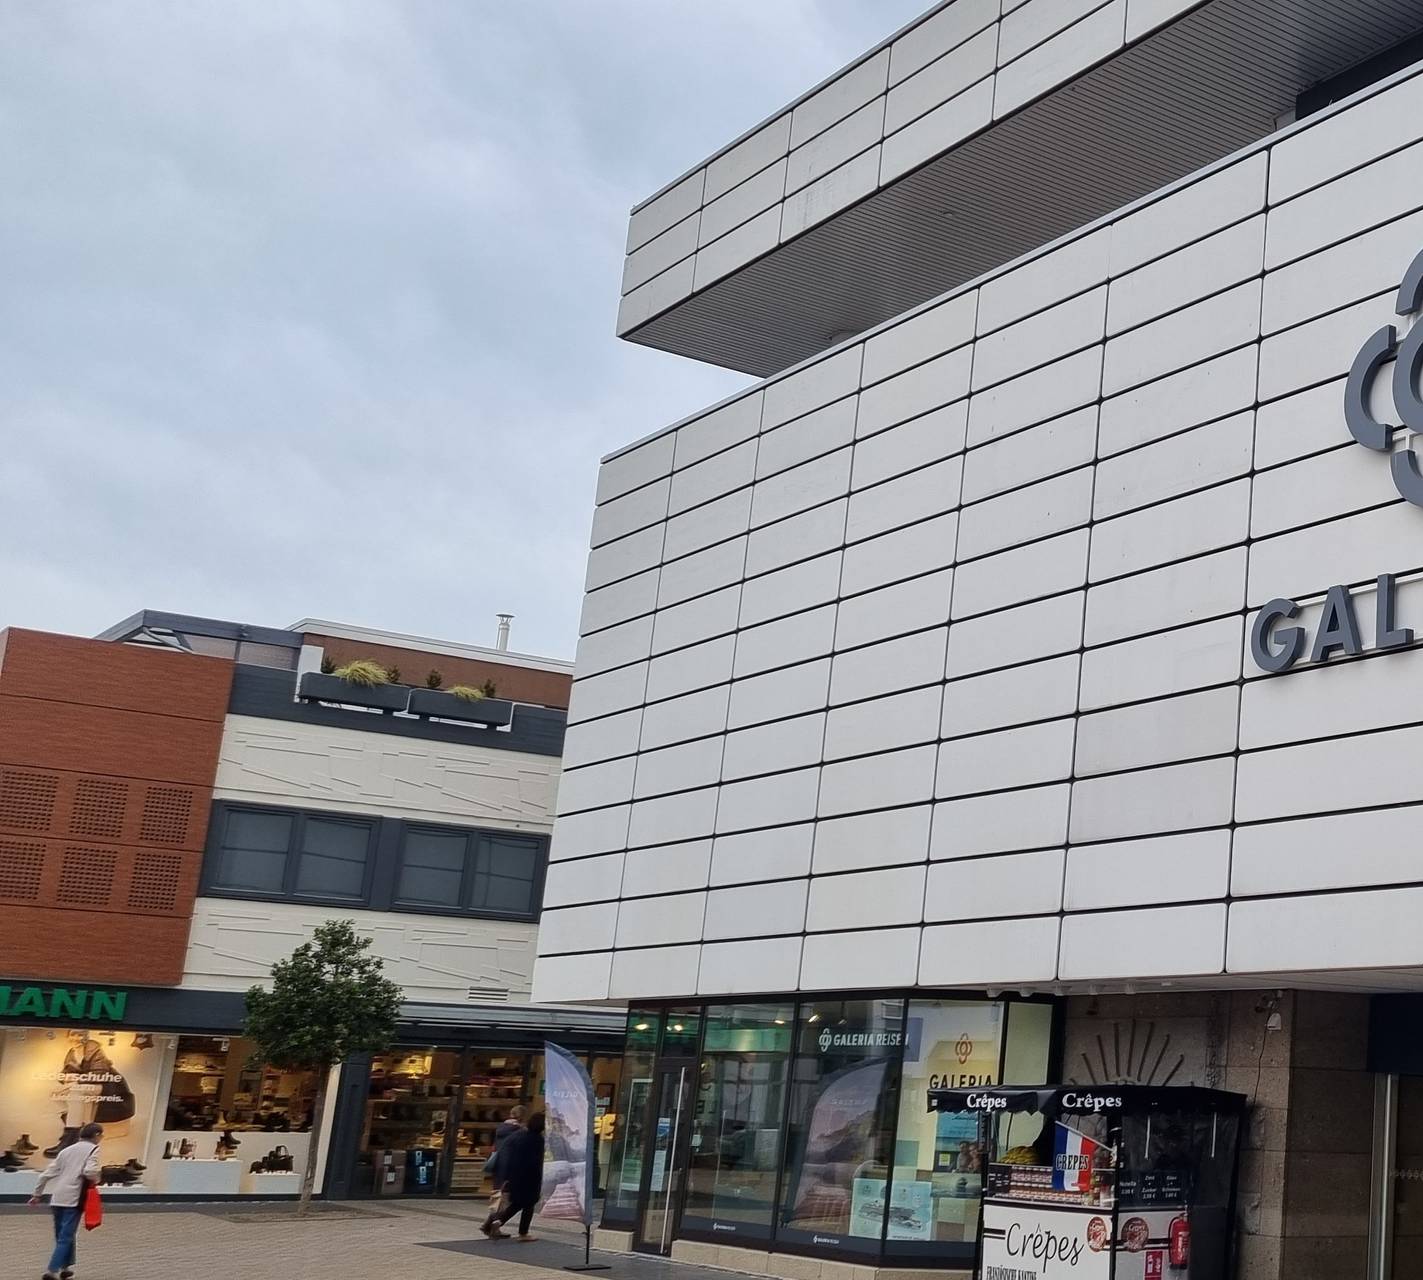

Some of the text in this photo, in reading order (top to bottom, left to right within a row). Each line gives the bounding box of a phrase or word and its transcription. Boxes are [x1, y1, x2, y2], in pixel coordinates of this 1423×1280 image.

[833, 1033, 874, 1046] GALERIA
[967, 1093, 1007, 1112] Crêpes
[1062, 1093, 1122, 1112] Crêpes
[1007, 1223, 1085, 1273] Crêpes
